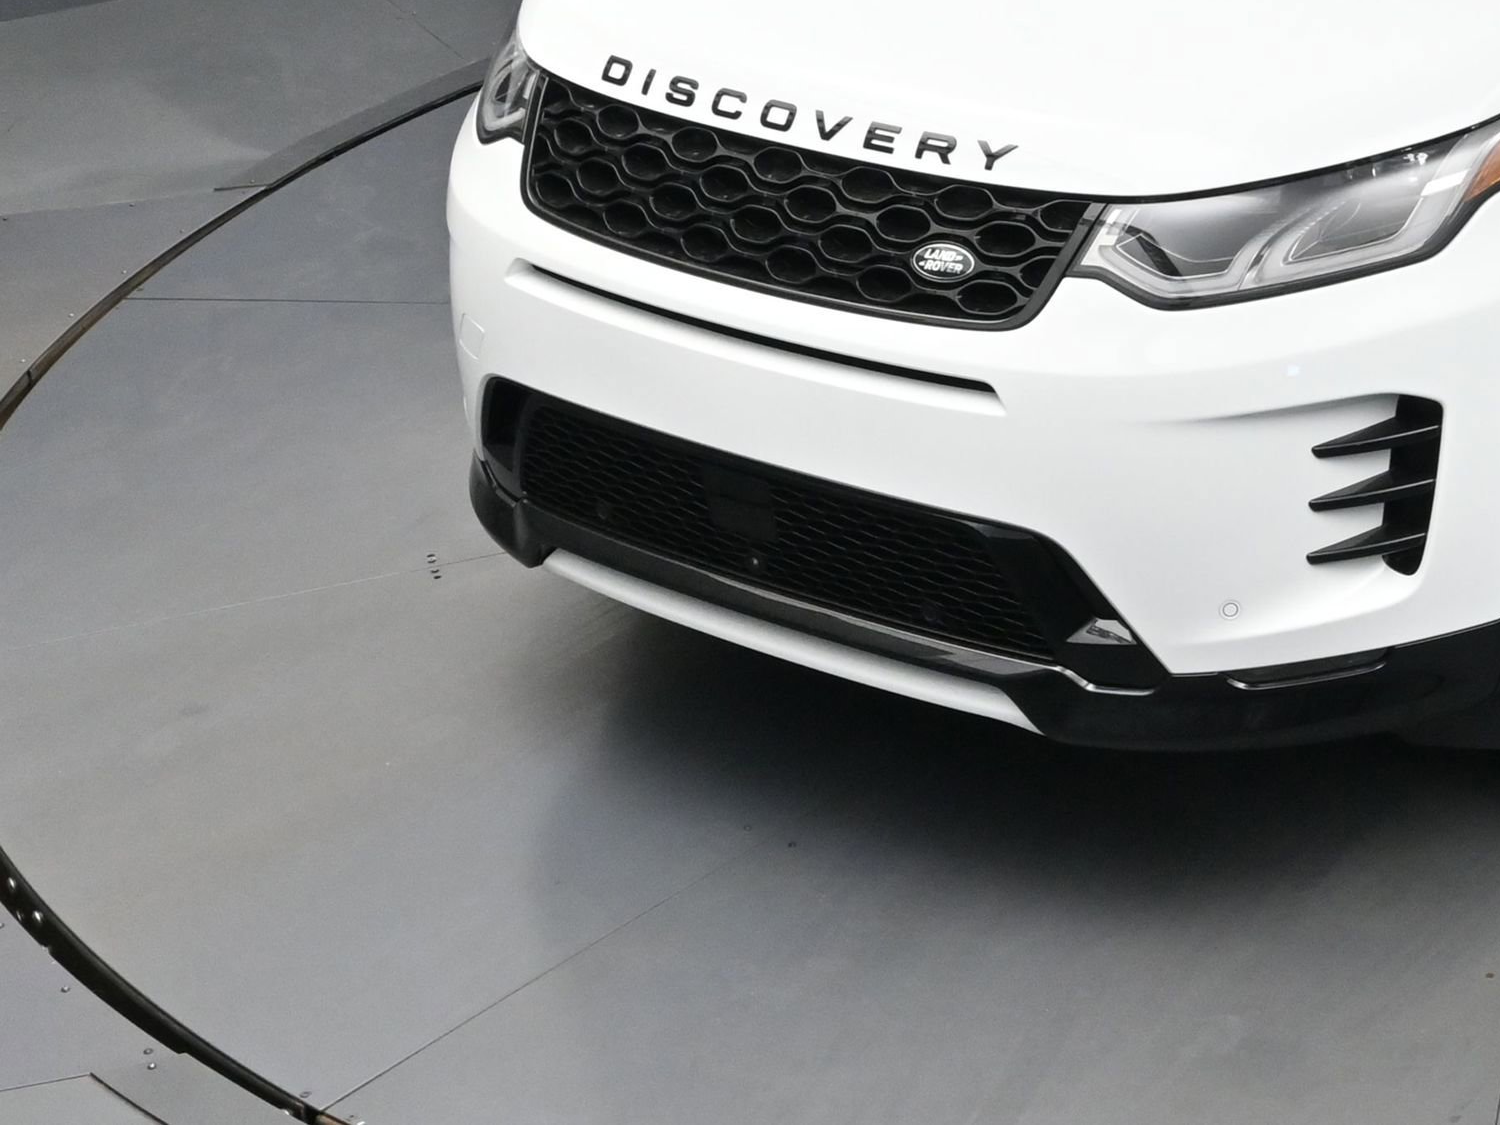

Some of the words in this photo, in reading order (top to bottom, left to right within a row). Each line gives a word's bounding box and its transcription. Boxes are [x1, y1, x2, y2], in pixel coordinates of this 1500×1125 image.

[601, 55, 1018, 171] DISCOVERY
[924, 248, 957, 262] LAND
[924, 259, 963, 274] ROVER
